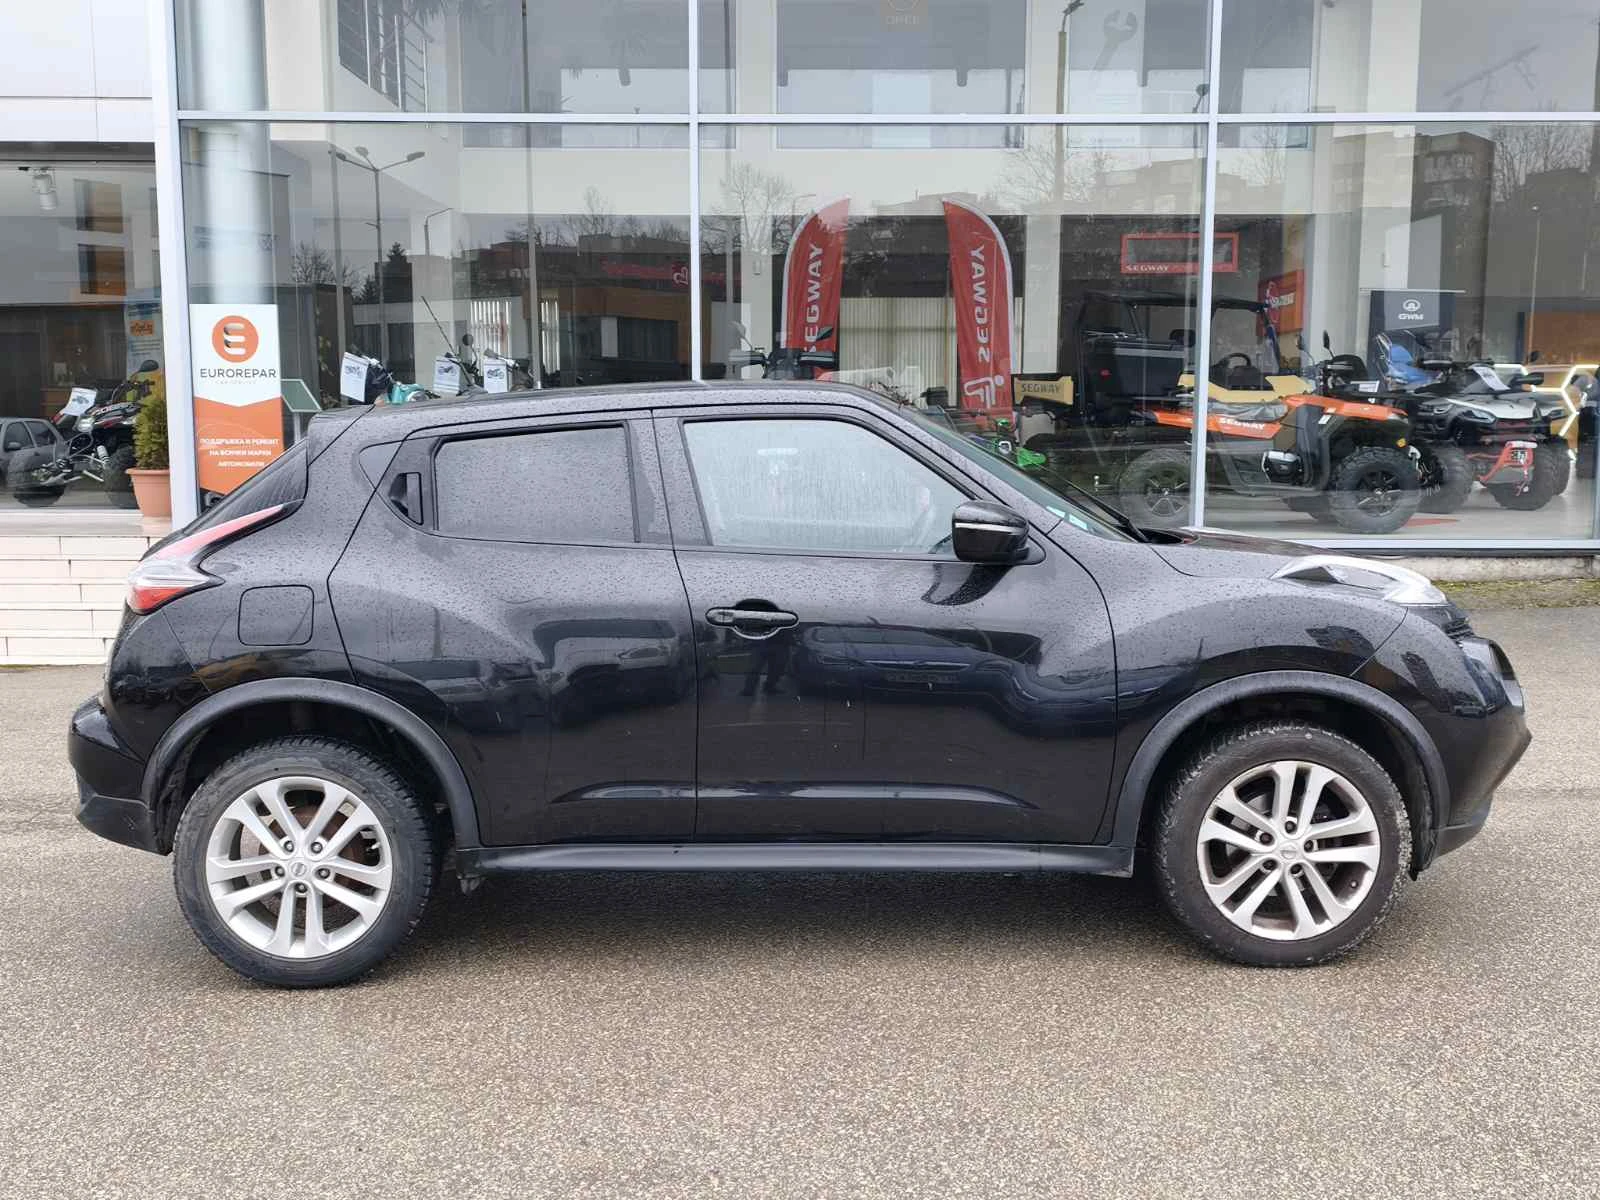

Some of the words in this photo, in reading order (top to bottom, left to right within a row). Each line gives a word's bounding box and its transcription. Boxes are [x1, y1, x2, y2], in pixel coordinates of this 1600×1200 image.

[1125, 264, 1169, 272] SEGWAY
[199, 368, 276, 378] EUROREPAR
[1022, 383, 1061, 393] SEGWAY
[1219, 416, 1265, 430] SEGWAY
